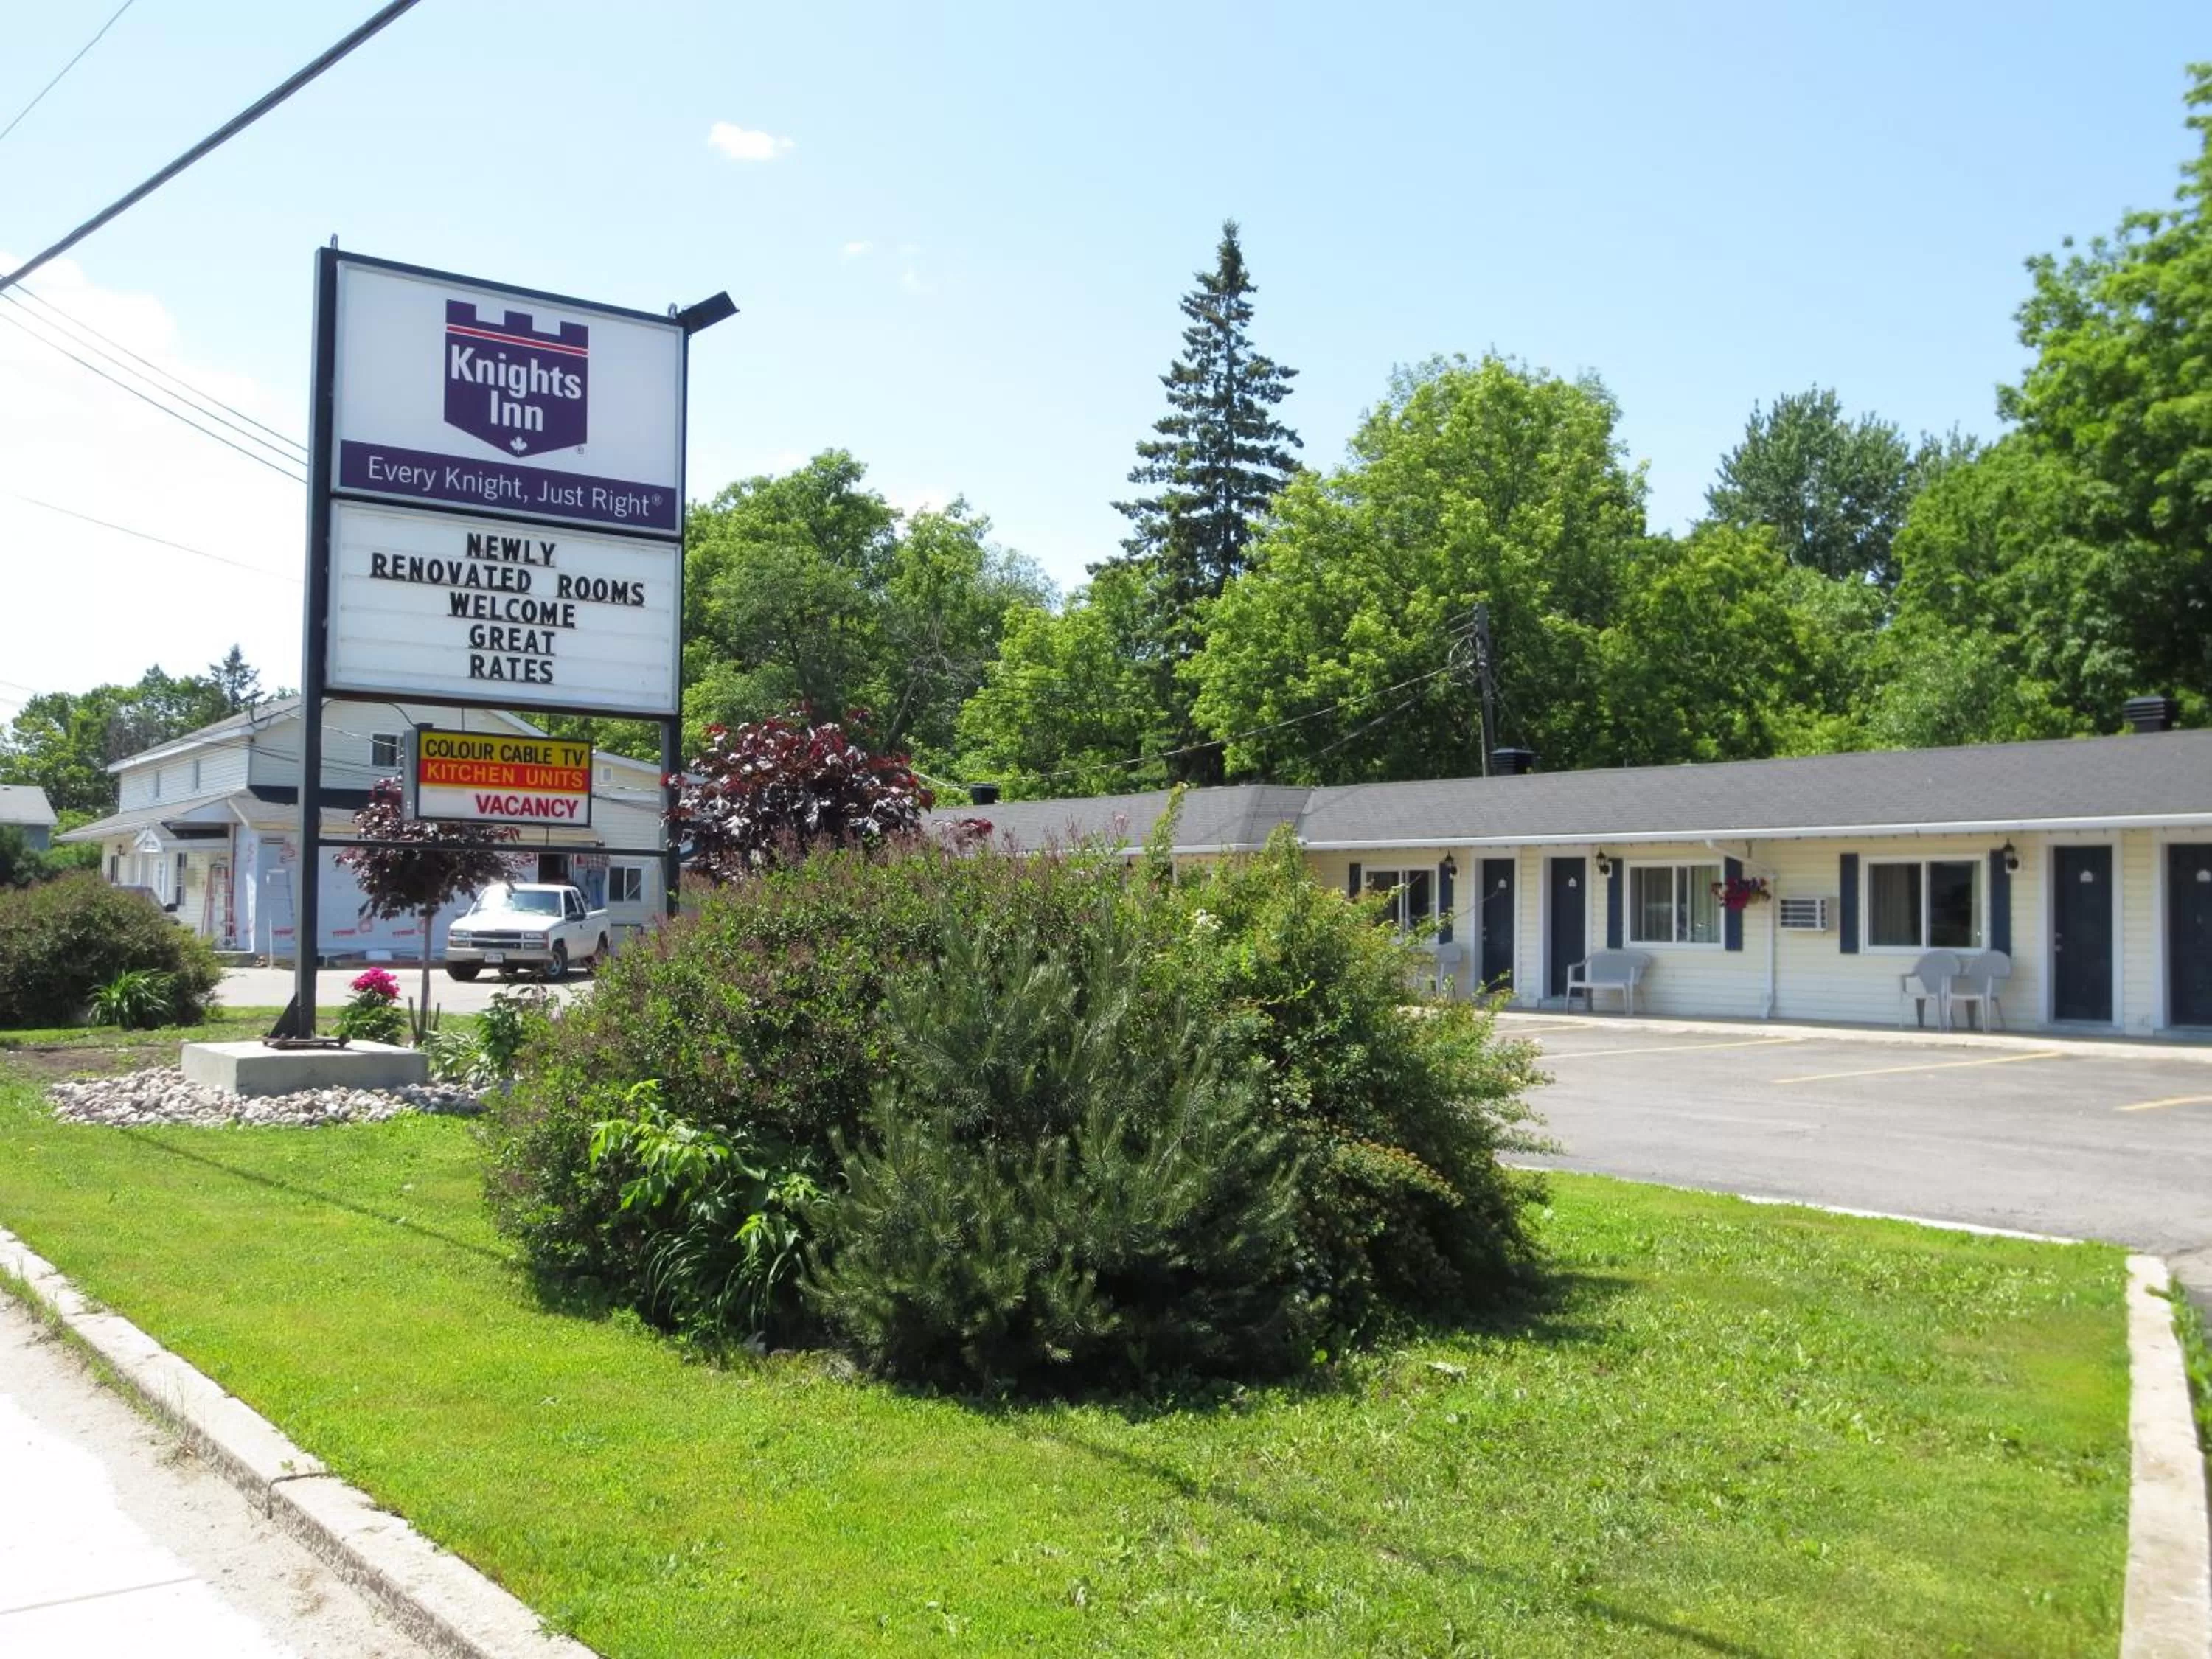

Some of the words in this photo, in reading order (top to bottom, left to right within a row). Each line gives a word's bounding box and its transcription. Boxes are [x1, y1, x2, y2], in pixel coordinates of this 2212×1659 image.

[451, 344, 582, 399] Knights
[490, 390, 543, 432] Inn
[368, 455, 437, 492] Every
[445, 466, 529, 504] Knight,
[537, 480, 584, 508] Just
[466, 532, 556, 566] NEWLY
[370, 552, 532, 593] RENOVATED
[557, 574, 645, 607] ROOMS
[449, 591, 576, 628] WELCOME
[469, 624, 556, 655] GREAT
[469, 654, 554, 684] RATES
[425, 739, 494, 761] COLOUR
[500, 744, 552, 765] CABLE
[562, 748, 585, 767] TV
[426, 762, 515, 784] KITCHEN
[526, 768, 584, 789] UNITS
[476, 793, 579, 818] VACANCY
